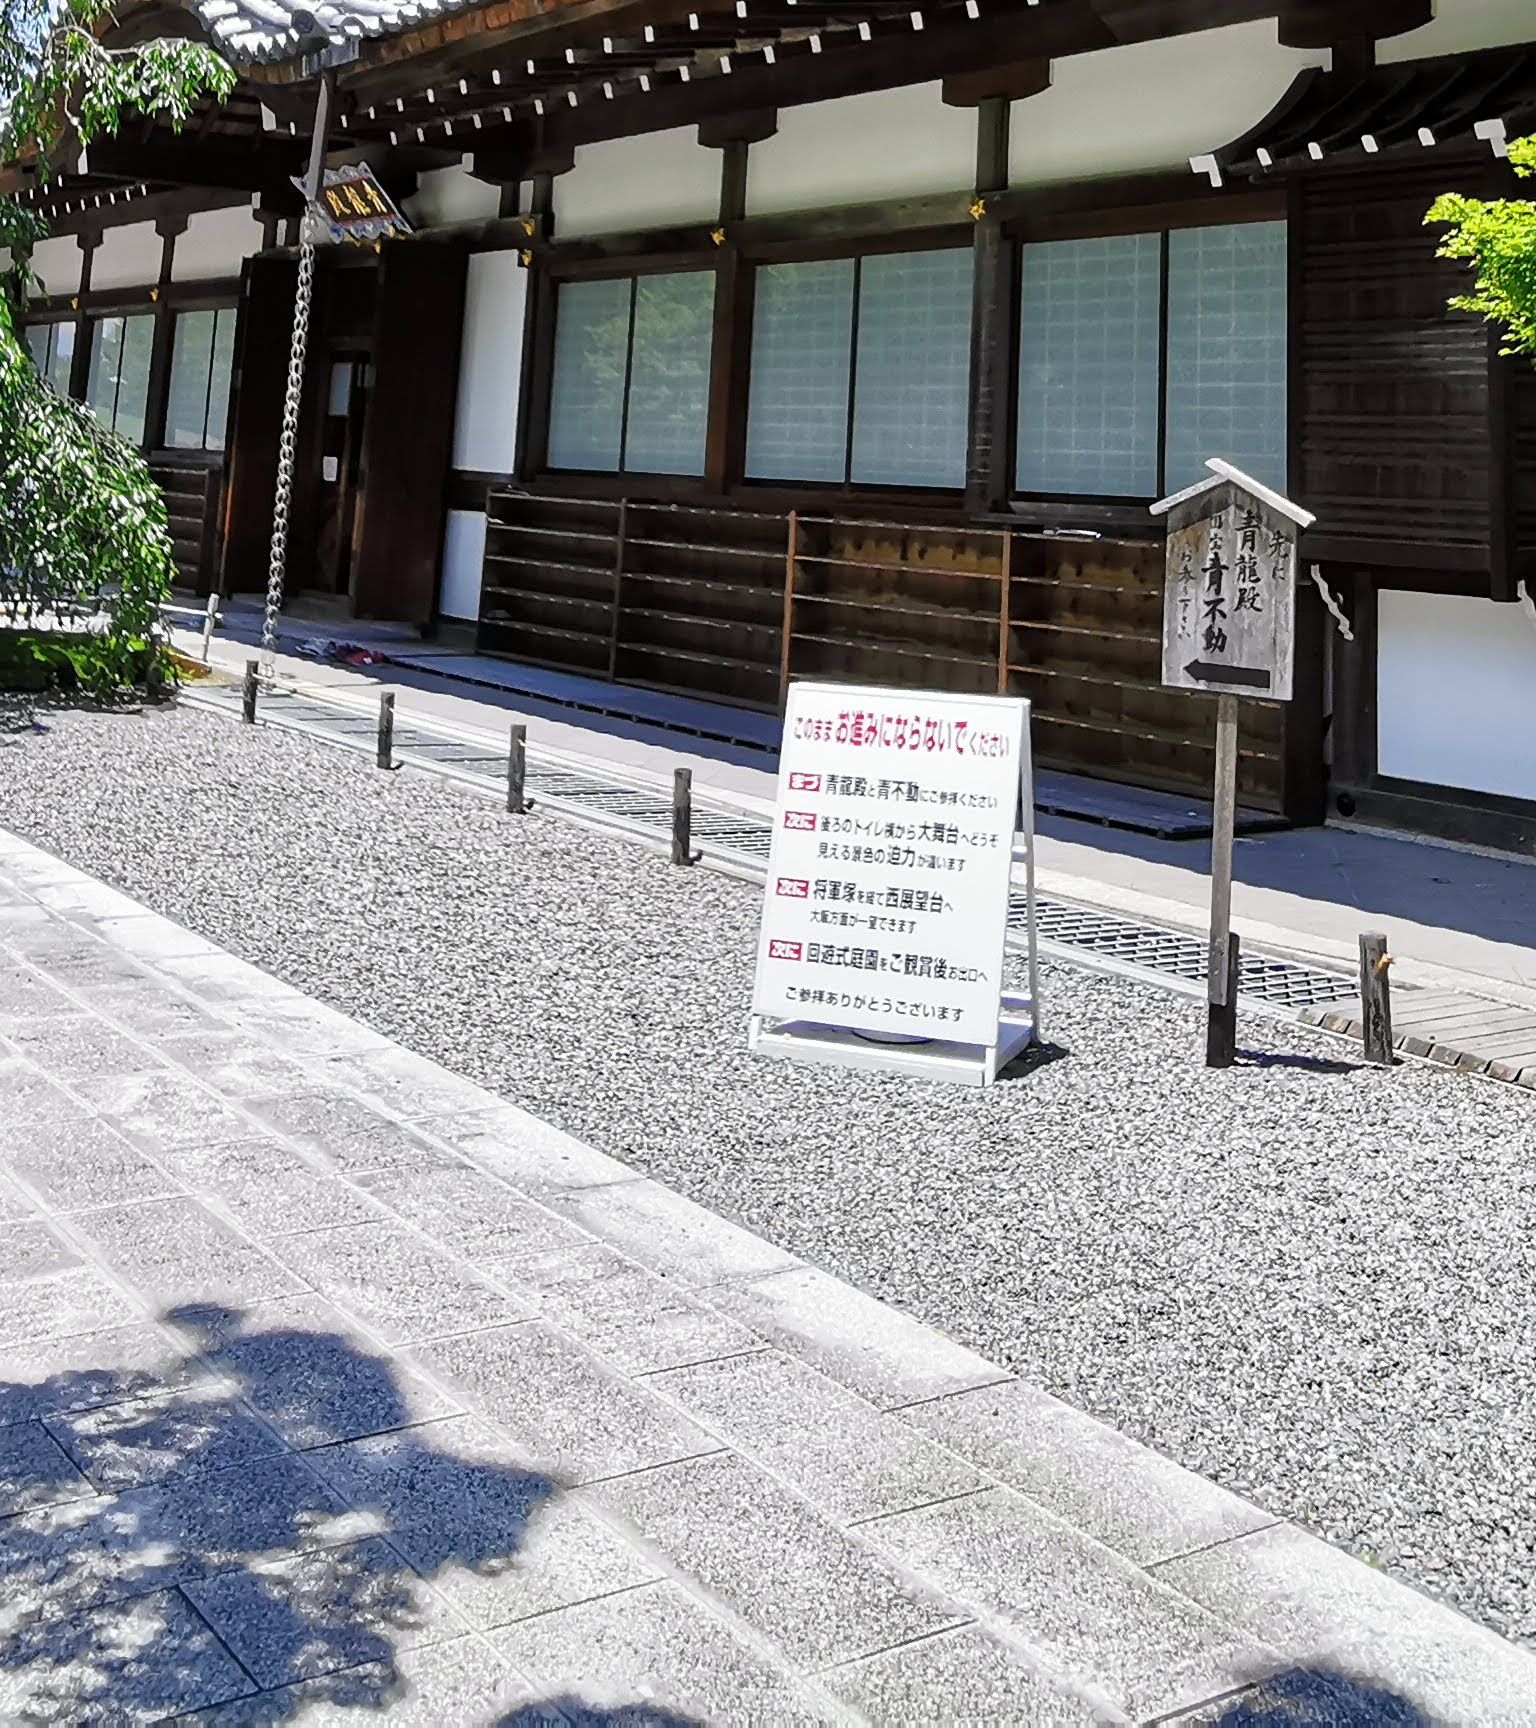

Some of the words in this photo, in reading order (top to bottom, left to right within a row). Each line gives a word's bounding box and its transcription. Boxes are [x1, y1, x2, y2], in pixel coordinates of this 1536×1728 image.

[1233, 509, 1263, 612] 青龍殿
[794, 710, 1009, 757] このままお進みにならないでください
[785, 813, 816, 829] 次に
[778, 880, 808, 897] 次に
[770, 941, 801, 959] 次に
[786, 987, 964, 1022] ご参拝ありがとうございます
